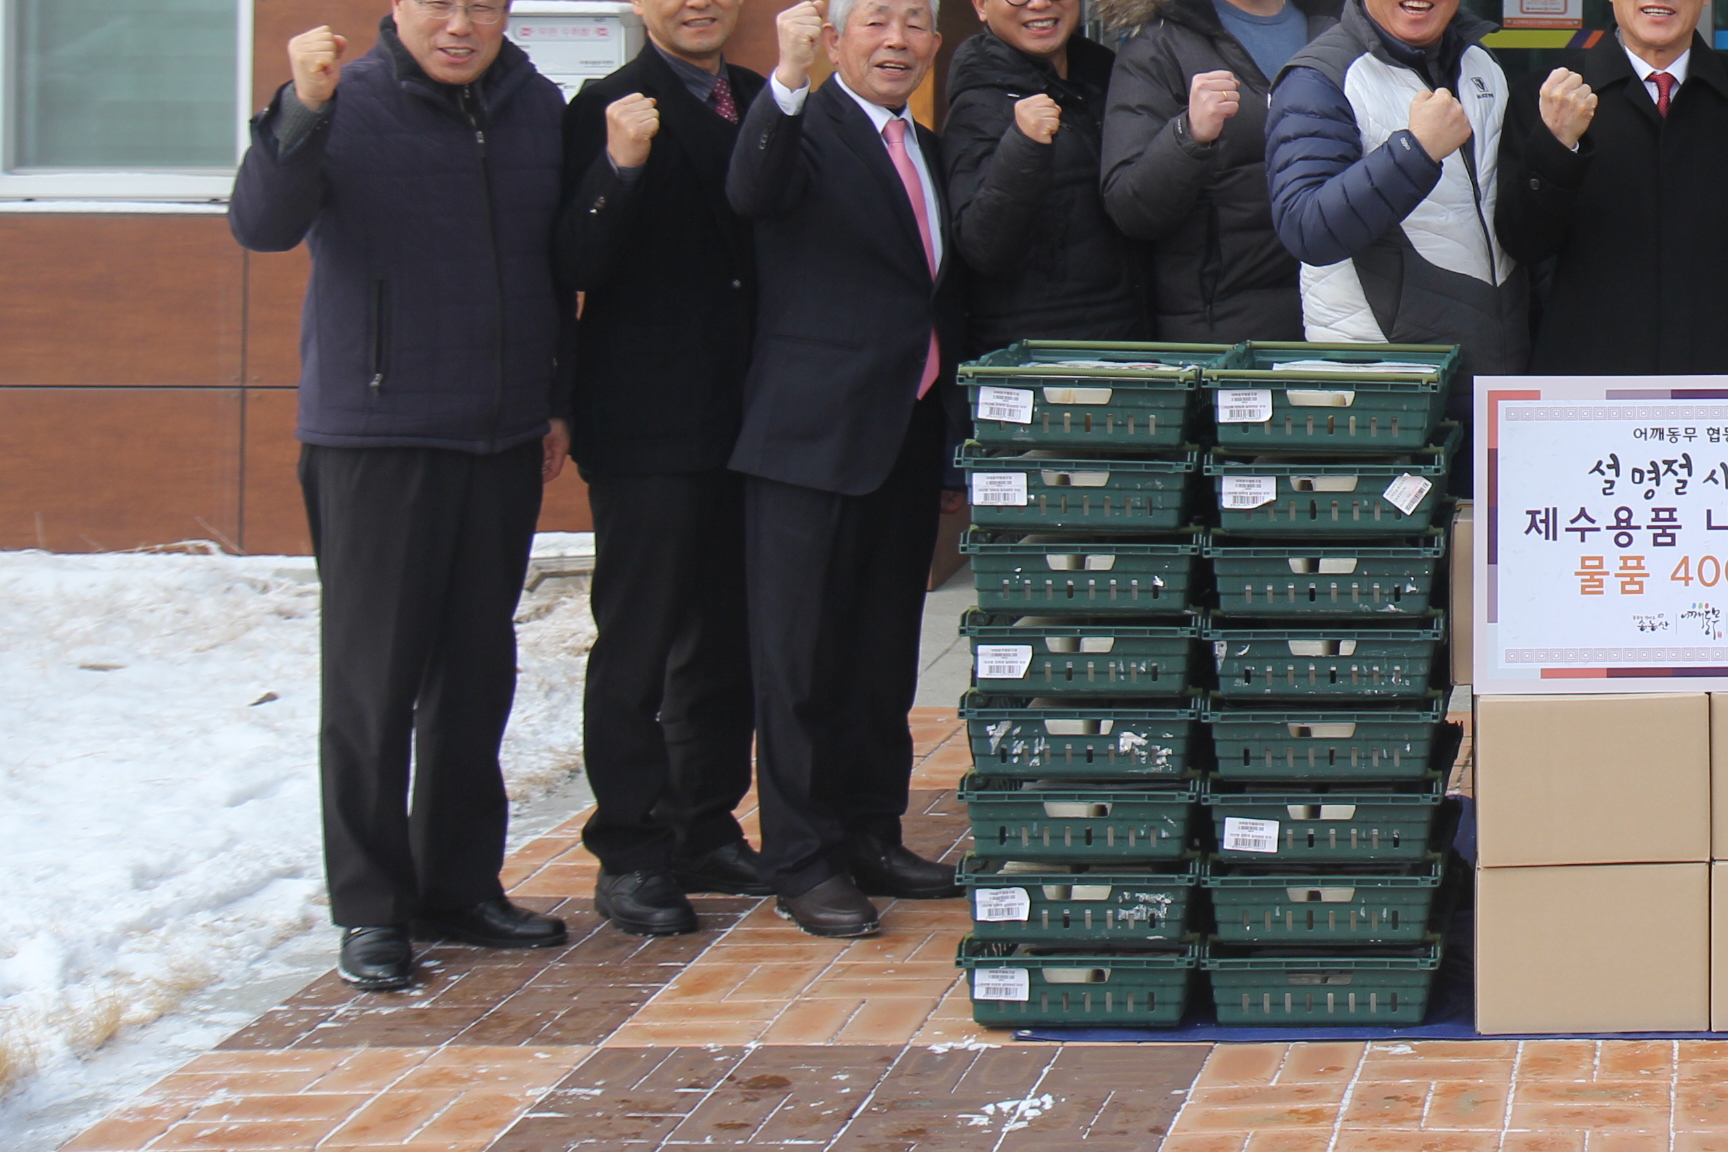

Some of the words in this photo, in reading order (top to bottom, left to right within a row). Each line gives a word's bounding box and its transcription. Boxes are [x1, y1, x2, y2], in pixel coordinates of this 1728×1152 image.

[1633, 427, 1698, 443] 어깨동무
[1588, 453, 1621, 496] 설
[1631, 452, 1693, 500] 명절
[1523, 505, 1683, 548] 제수용품
[1574, 555, 1650, 595] 물품
